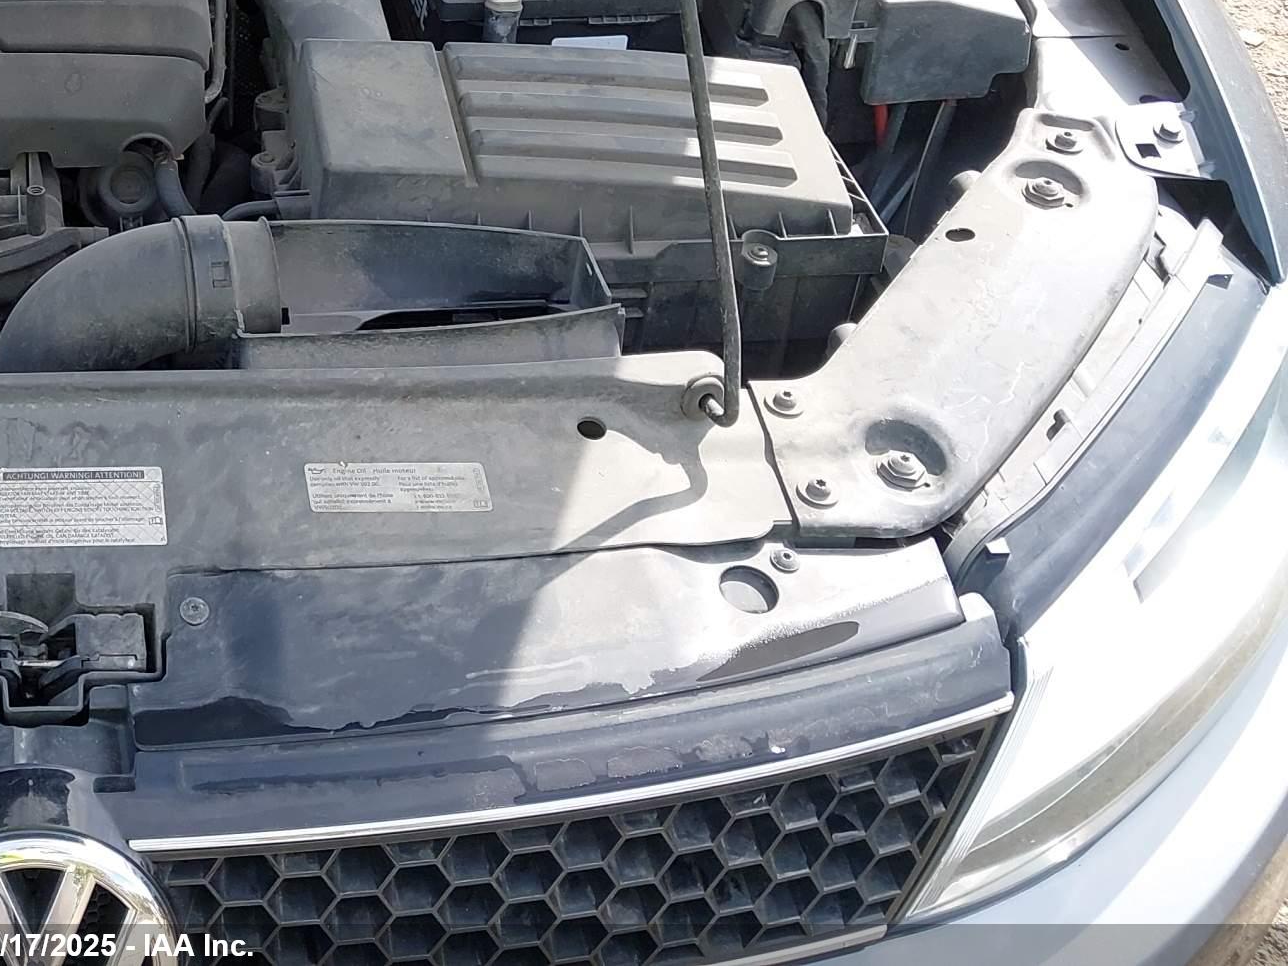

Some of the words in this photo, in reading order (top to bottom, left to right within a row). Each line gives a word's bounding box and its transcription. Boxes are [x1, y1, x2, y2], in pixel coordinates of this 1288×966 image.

[6, 472, 49, 480] ACHTUNG!
[51, 472, 93, 480] WARNING!
[94, 470, 143, 479] ATTENTION!
